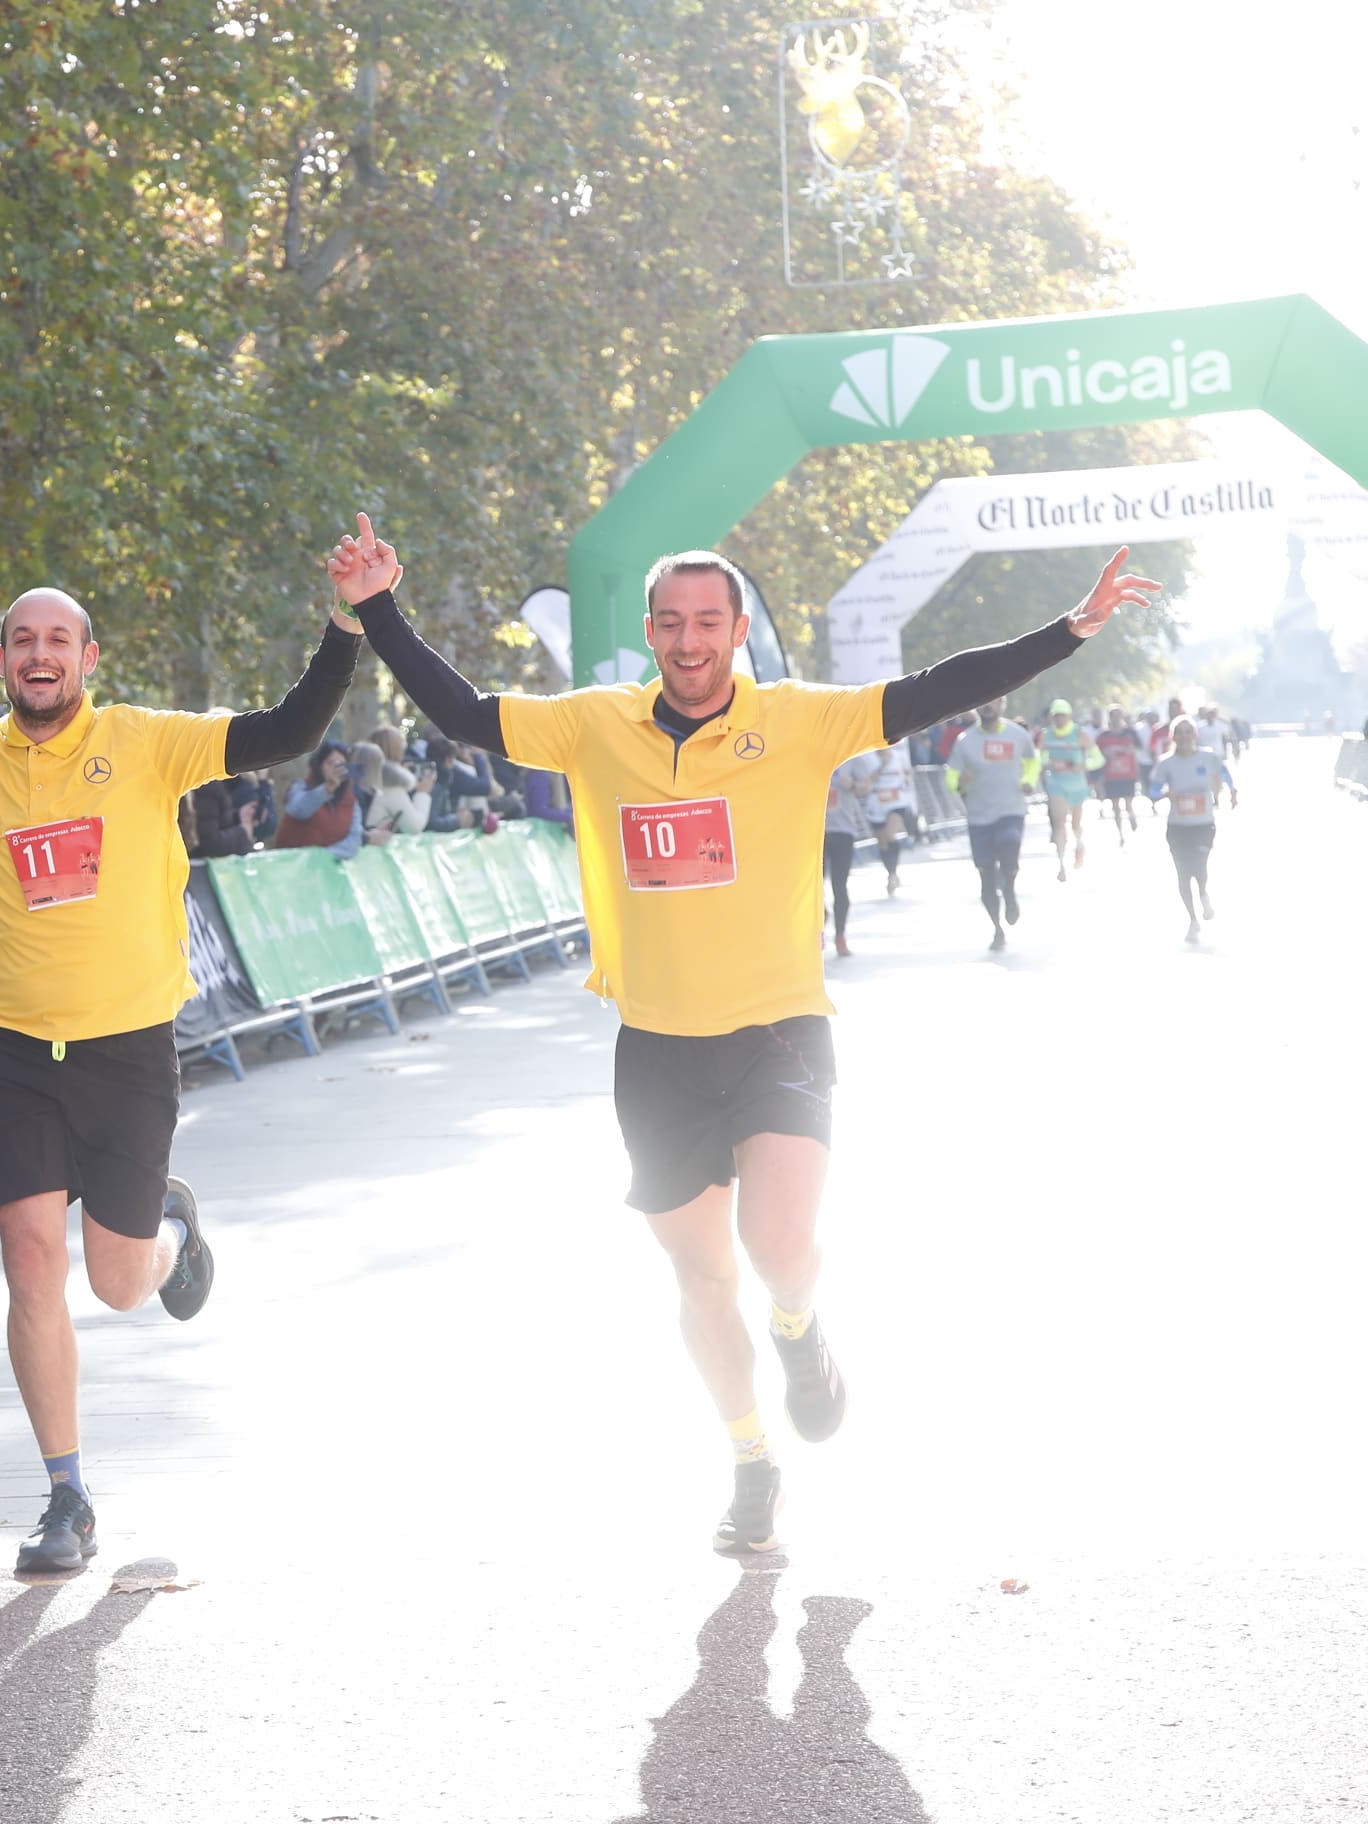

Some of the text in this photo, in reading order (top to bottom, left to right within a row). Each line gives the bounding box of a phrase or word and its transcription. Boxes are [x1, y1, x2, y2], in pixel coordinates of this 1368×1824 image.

[967, 339, 1231, 413] Unicaja
[978, 480, 1274, 531] El Norte de Castilla
[23, 840, 56, 878] 11
[640, 821, 676, 858] 10
